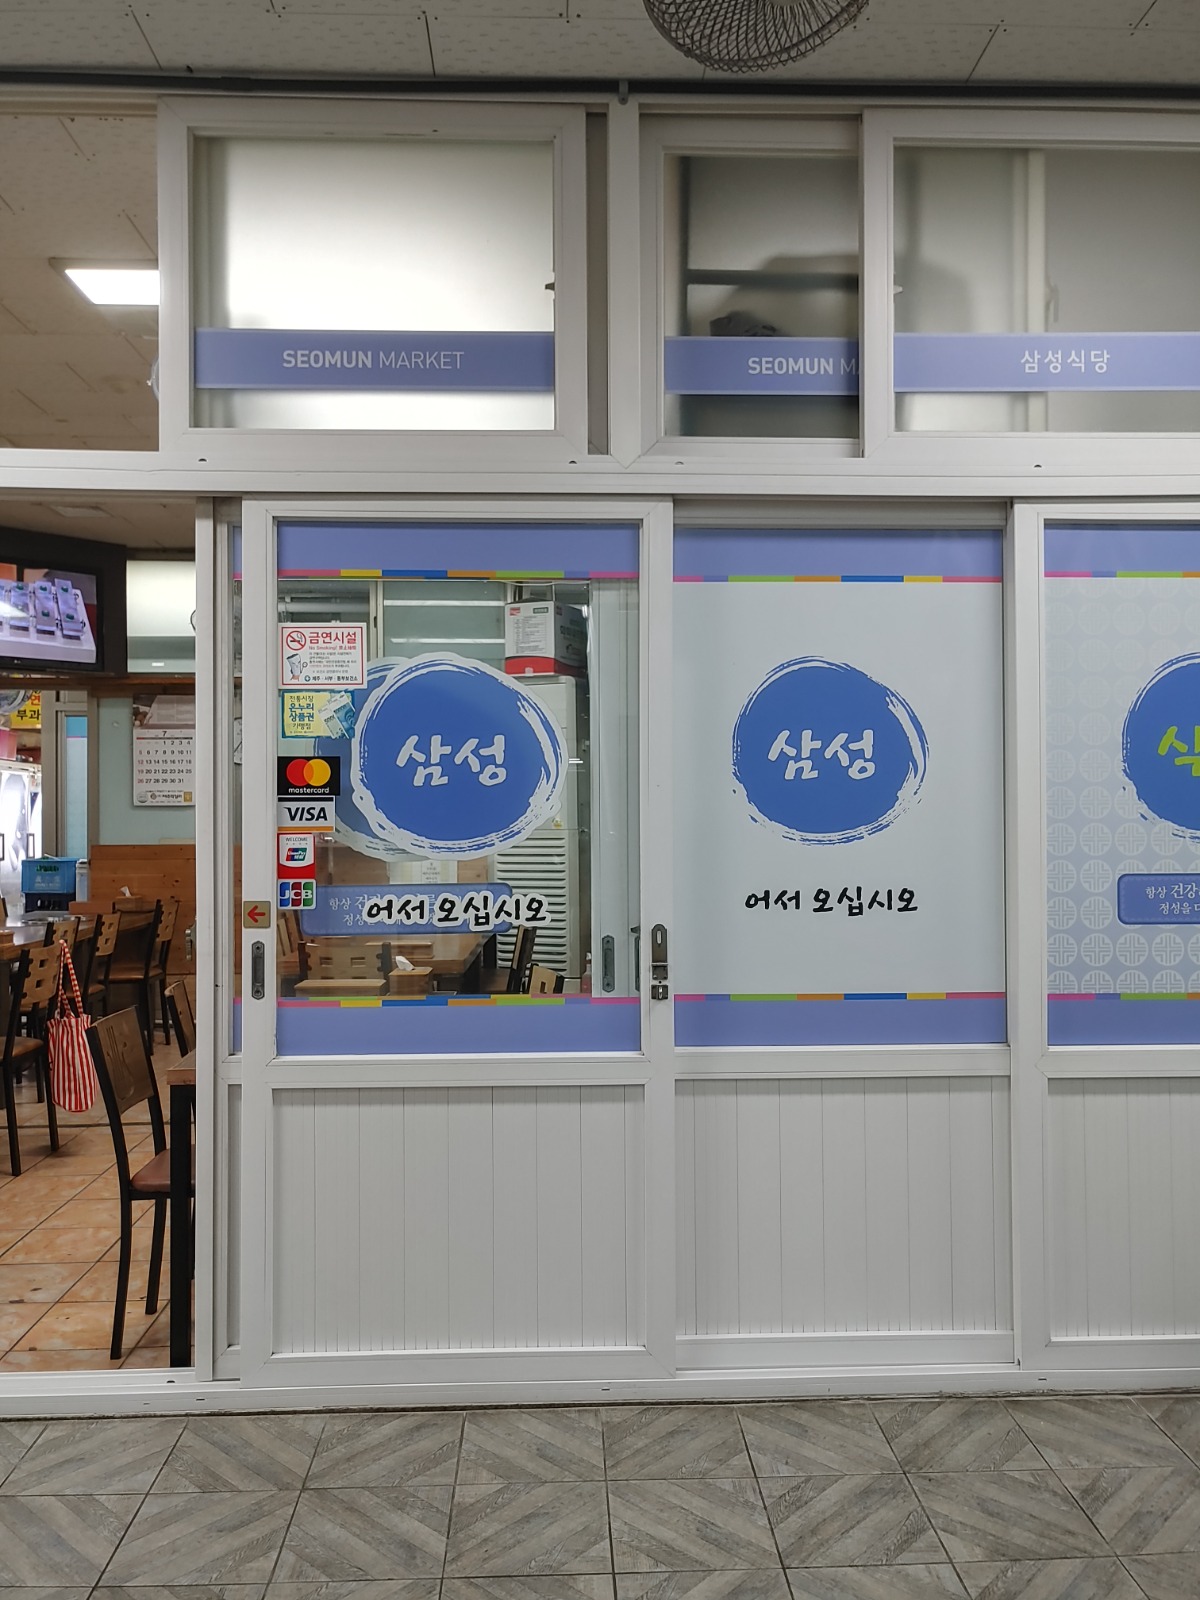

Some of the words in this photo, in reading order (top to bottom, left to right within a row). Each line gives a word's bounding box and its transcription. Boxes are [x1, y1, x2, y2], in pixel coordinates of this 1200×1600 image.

[282, 350, 372, 369] SEOMUN
[379, 351, 465, 369] MARKET
[748, 357, 834, 375] SEOMUN
[840, 358, 859, 375] M
[1020, 349, 1111, 374] 삼성식당
[308, 631, 357, 645] 금연시설
[288, 702, 315, 712] 온누리
[288, 712, 315, 722] 상품권
[395, 734, 507, 787] 삼성
[767, 729, 876, 780] 삼성
[283, 806, 328, 822] VISA
[279, 889, 313, 899] JCB
[1145, 886, 1167, 899] 항상
[1170, 882, 1200, 899] 건강
[329, 897, 351, 911] 항상
[745, 889, 800, 911] 어서
[812, 886, 919, 917] 오십시오
[1159, 901, 1192, 915] 정성을
[366, 899, 425, 920] 어서
[437, 895, 547, 927] 오십시오
